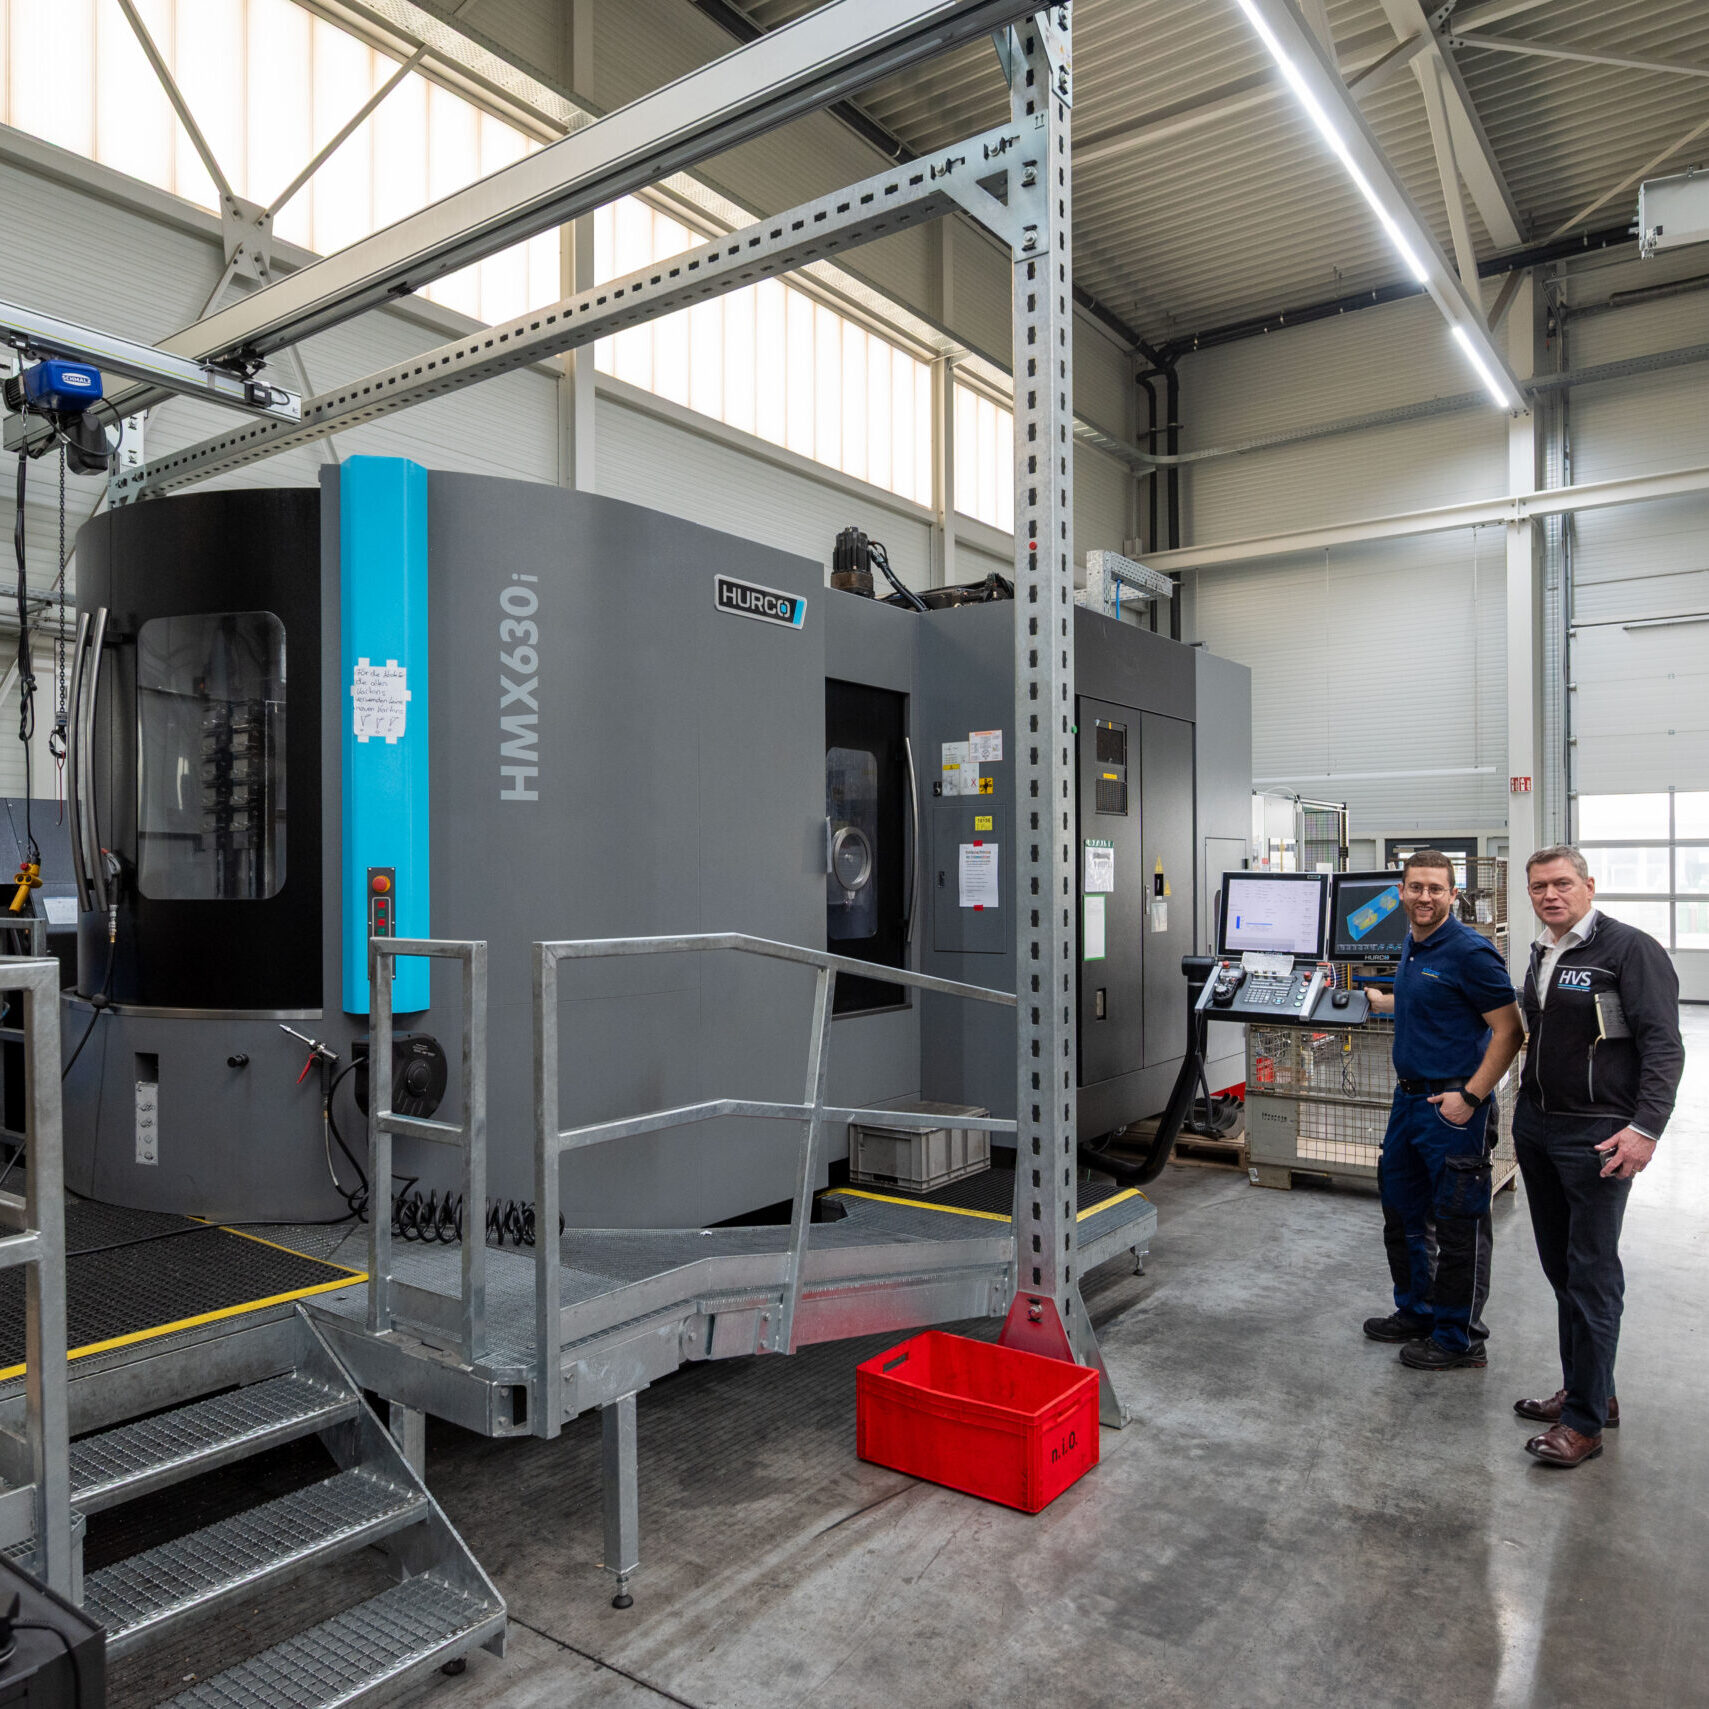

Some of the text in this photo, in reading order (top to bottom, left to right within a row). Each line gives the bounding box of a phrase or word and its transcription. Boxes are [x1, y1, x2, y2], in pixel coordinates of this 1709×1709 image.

[62, 375, 91, 384] SCHMALZ
[723, 584, 791, 618] HURCO
[500, 573, 539, 801] HMX630i
[1558, 970, 1592, 987] HVS
